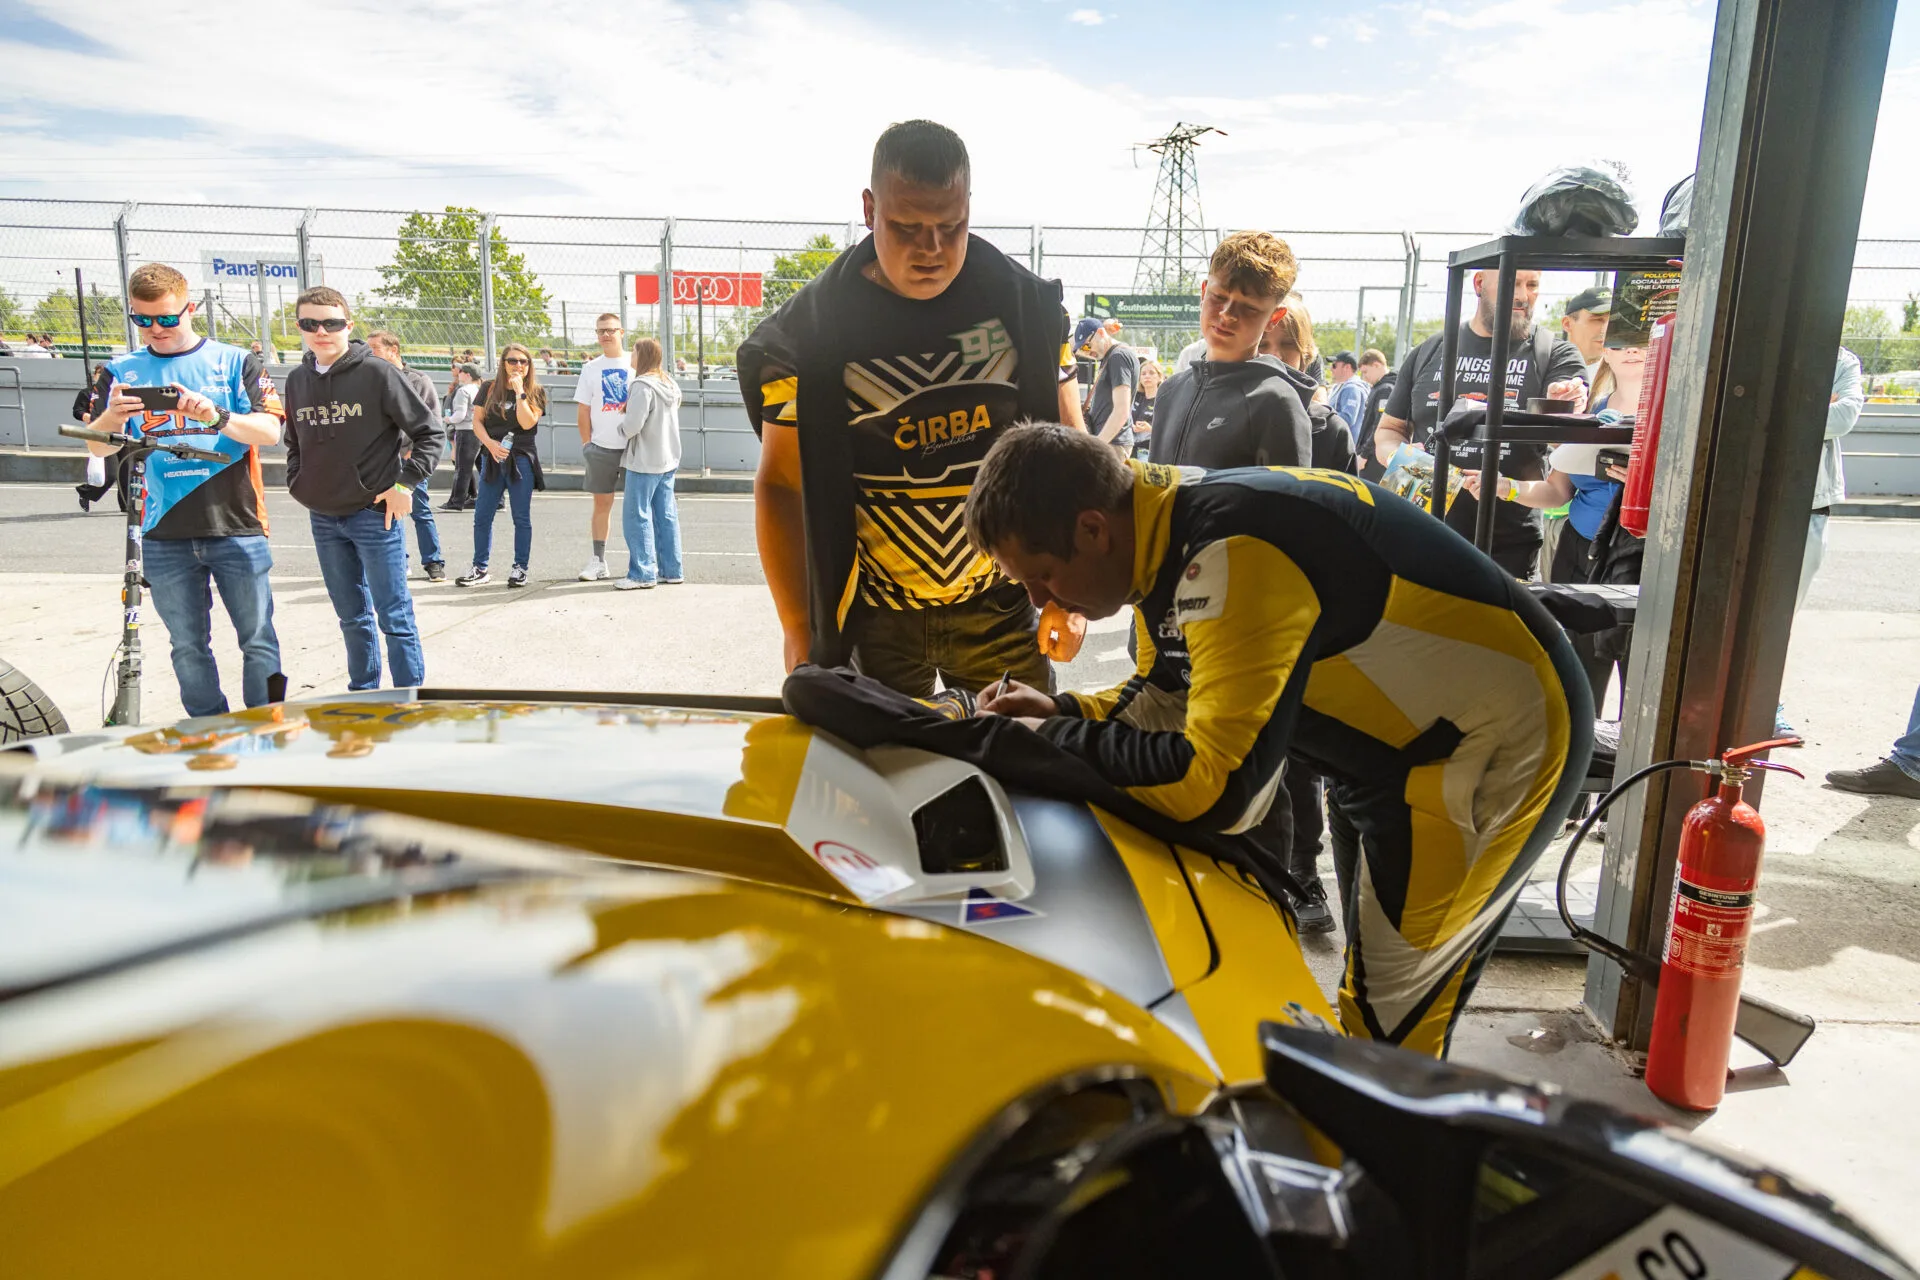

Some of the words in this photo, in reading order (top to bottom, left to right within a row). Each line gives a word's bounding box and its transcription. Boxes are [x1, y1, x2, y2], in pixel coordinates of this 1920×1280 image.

[1117, 303, 1158, 312] Southside
[1160, 304, 1183, 312] Motor
[1463, 372, 1490, 383] SPAR
[1505, 374, 1524, 386] IME
[894, 404, 991, 450] ČIRBA
